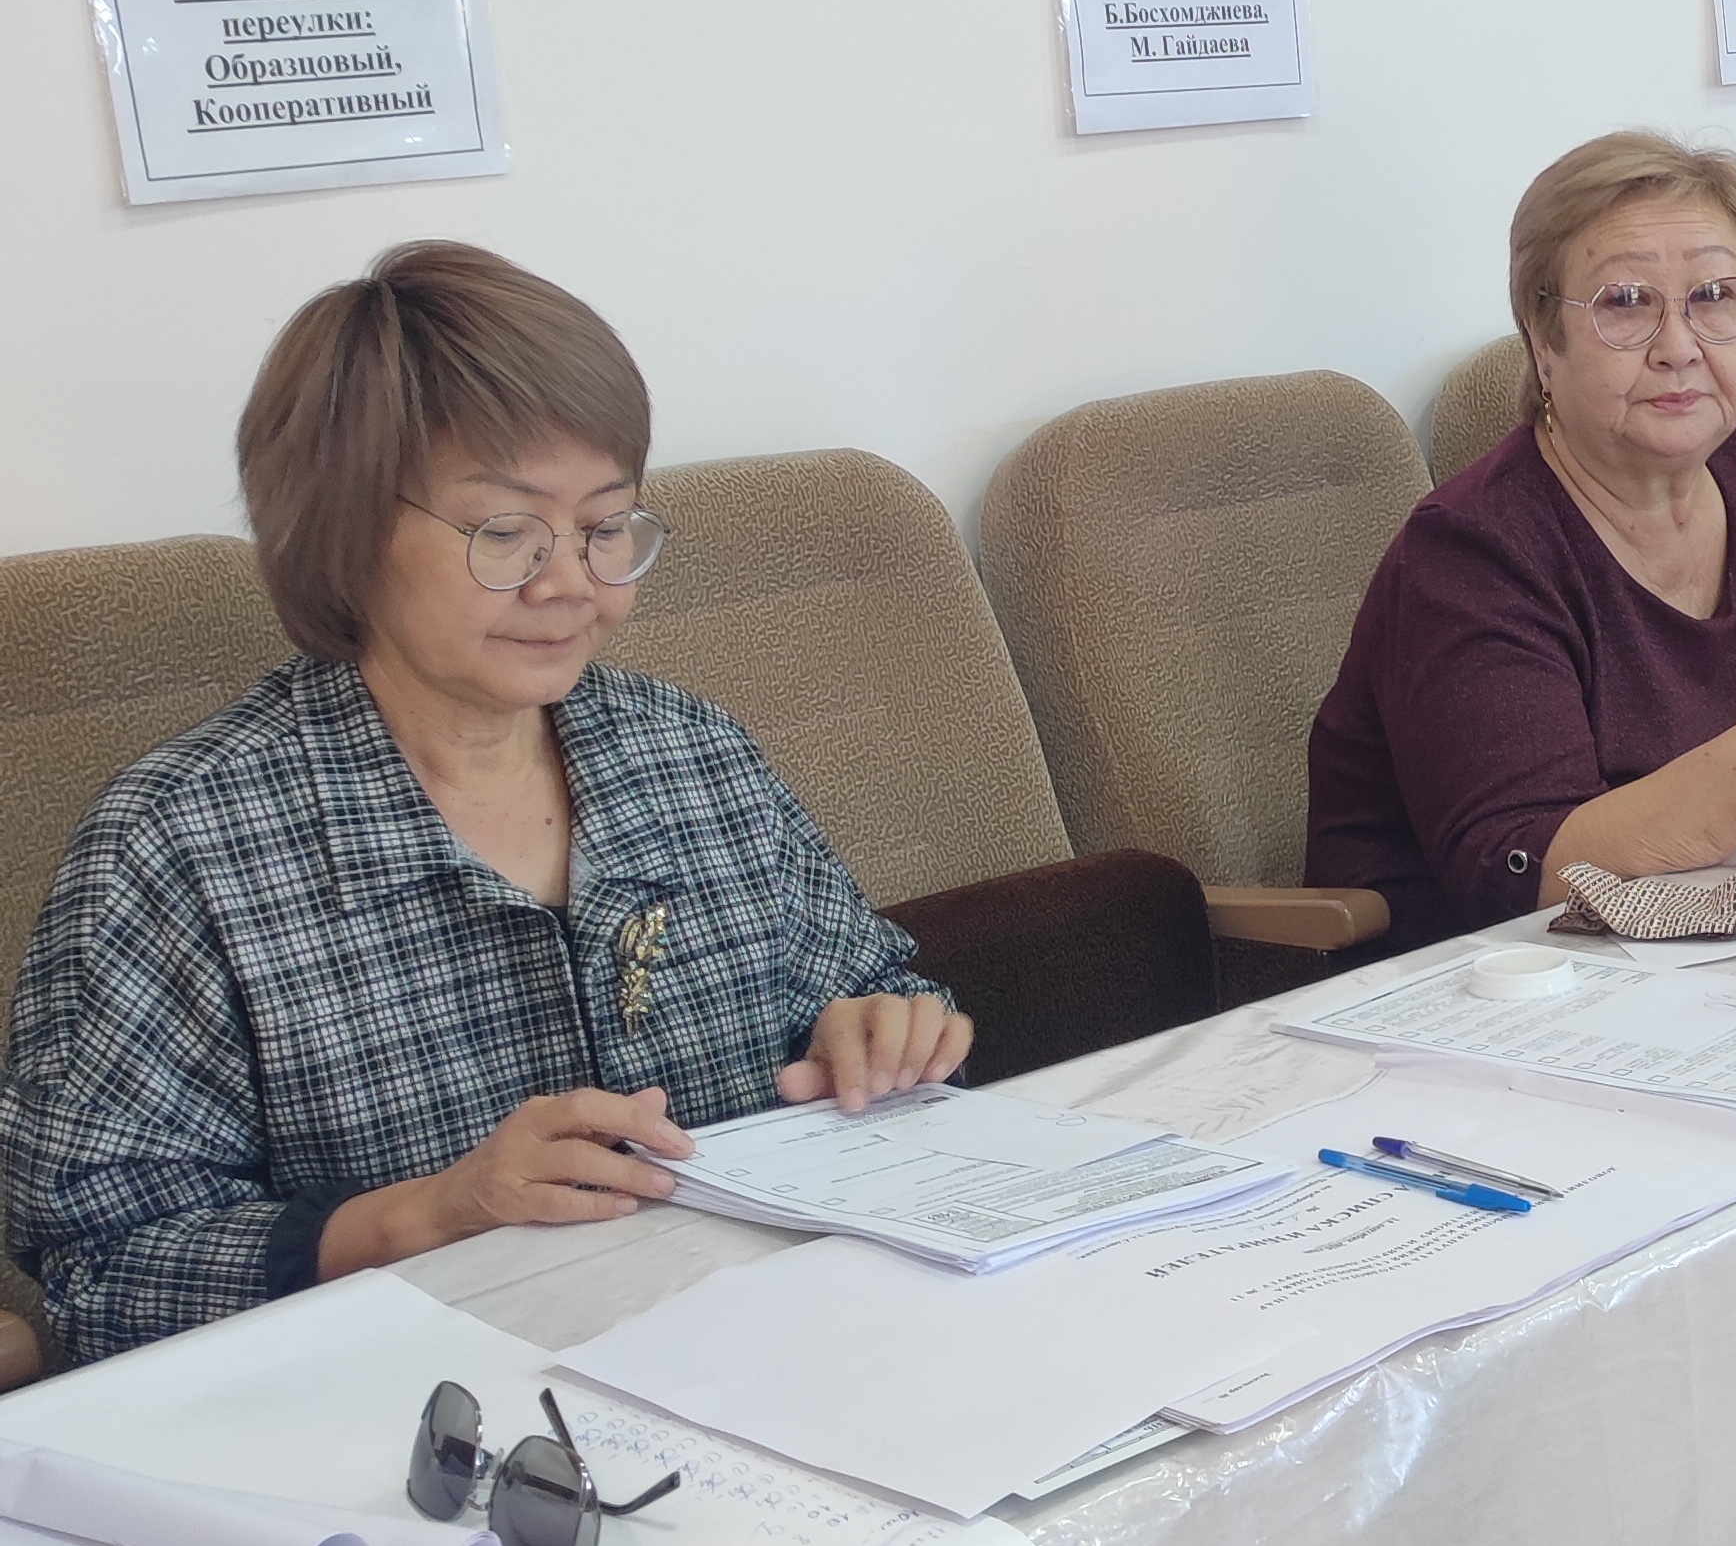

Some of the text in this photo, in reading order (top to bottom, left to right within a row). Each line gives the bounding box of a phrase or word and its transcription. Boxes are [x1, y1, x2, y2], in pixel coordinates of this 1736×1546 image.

[221, 9, 375, 41] переулки:
[1104, 2, 1269, 26] Б.Босхомджиева,
[205, 44, 403, 84] Образцовый,
[1130, 33, 1250, 57] М. Гайдаева
[192, 83, 434, 127] Кооперативный
[1305, 1191, 1395, 1235] СПИСКА
[1144, 1228, 1308, 1279] ИЗБИРАТЕЛЕЙ
